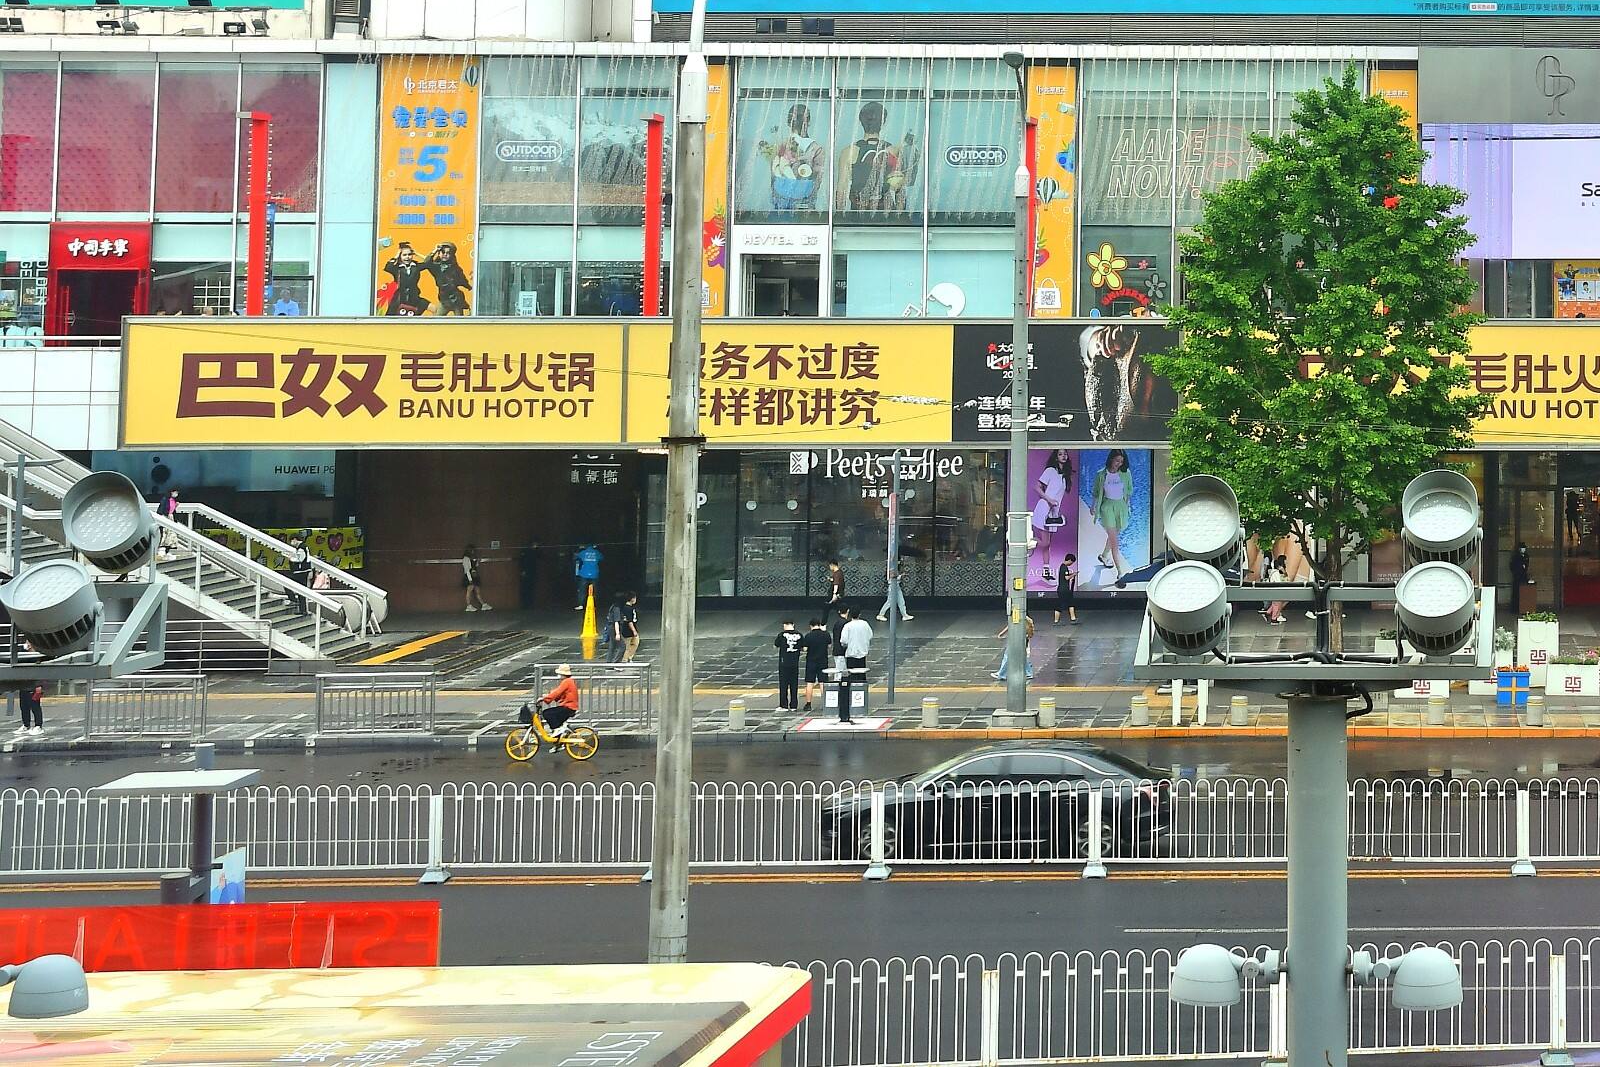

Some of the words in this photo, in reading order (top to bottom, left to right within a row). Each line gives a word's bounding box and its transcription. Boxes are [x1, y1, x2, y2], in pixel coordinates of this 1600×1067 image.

[1111, 129, 1206, 163] AAPE
[413, 145, 449, 183] 5
[1107, 165, 1206, 200] NOW!
[744, 234, 794, 246] HEYTEA
[175, 347, 388, 419] 巴奴
[399, 350, 596, 394] 毛肚火锅
[399, 398, 476, 419] BANU
[483, 398, 594, 419] HOTPOT
[977, 395, 1046, 411] 连续年
[274, 465, 320, 474] HUAWEI
